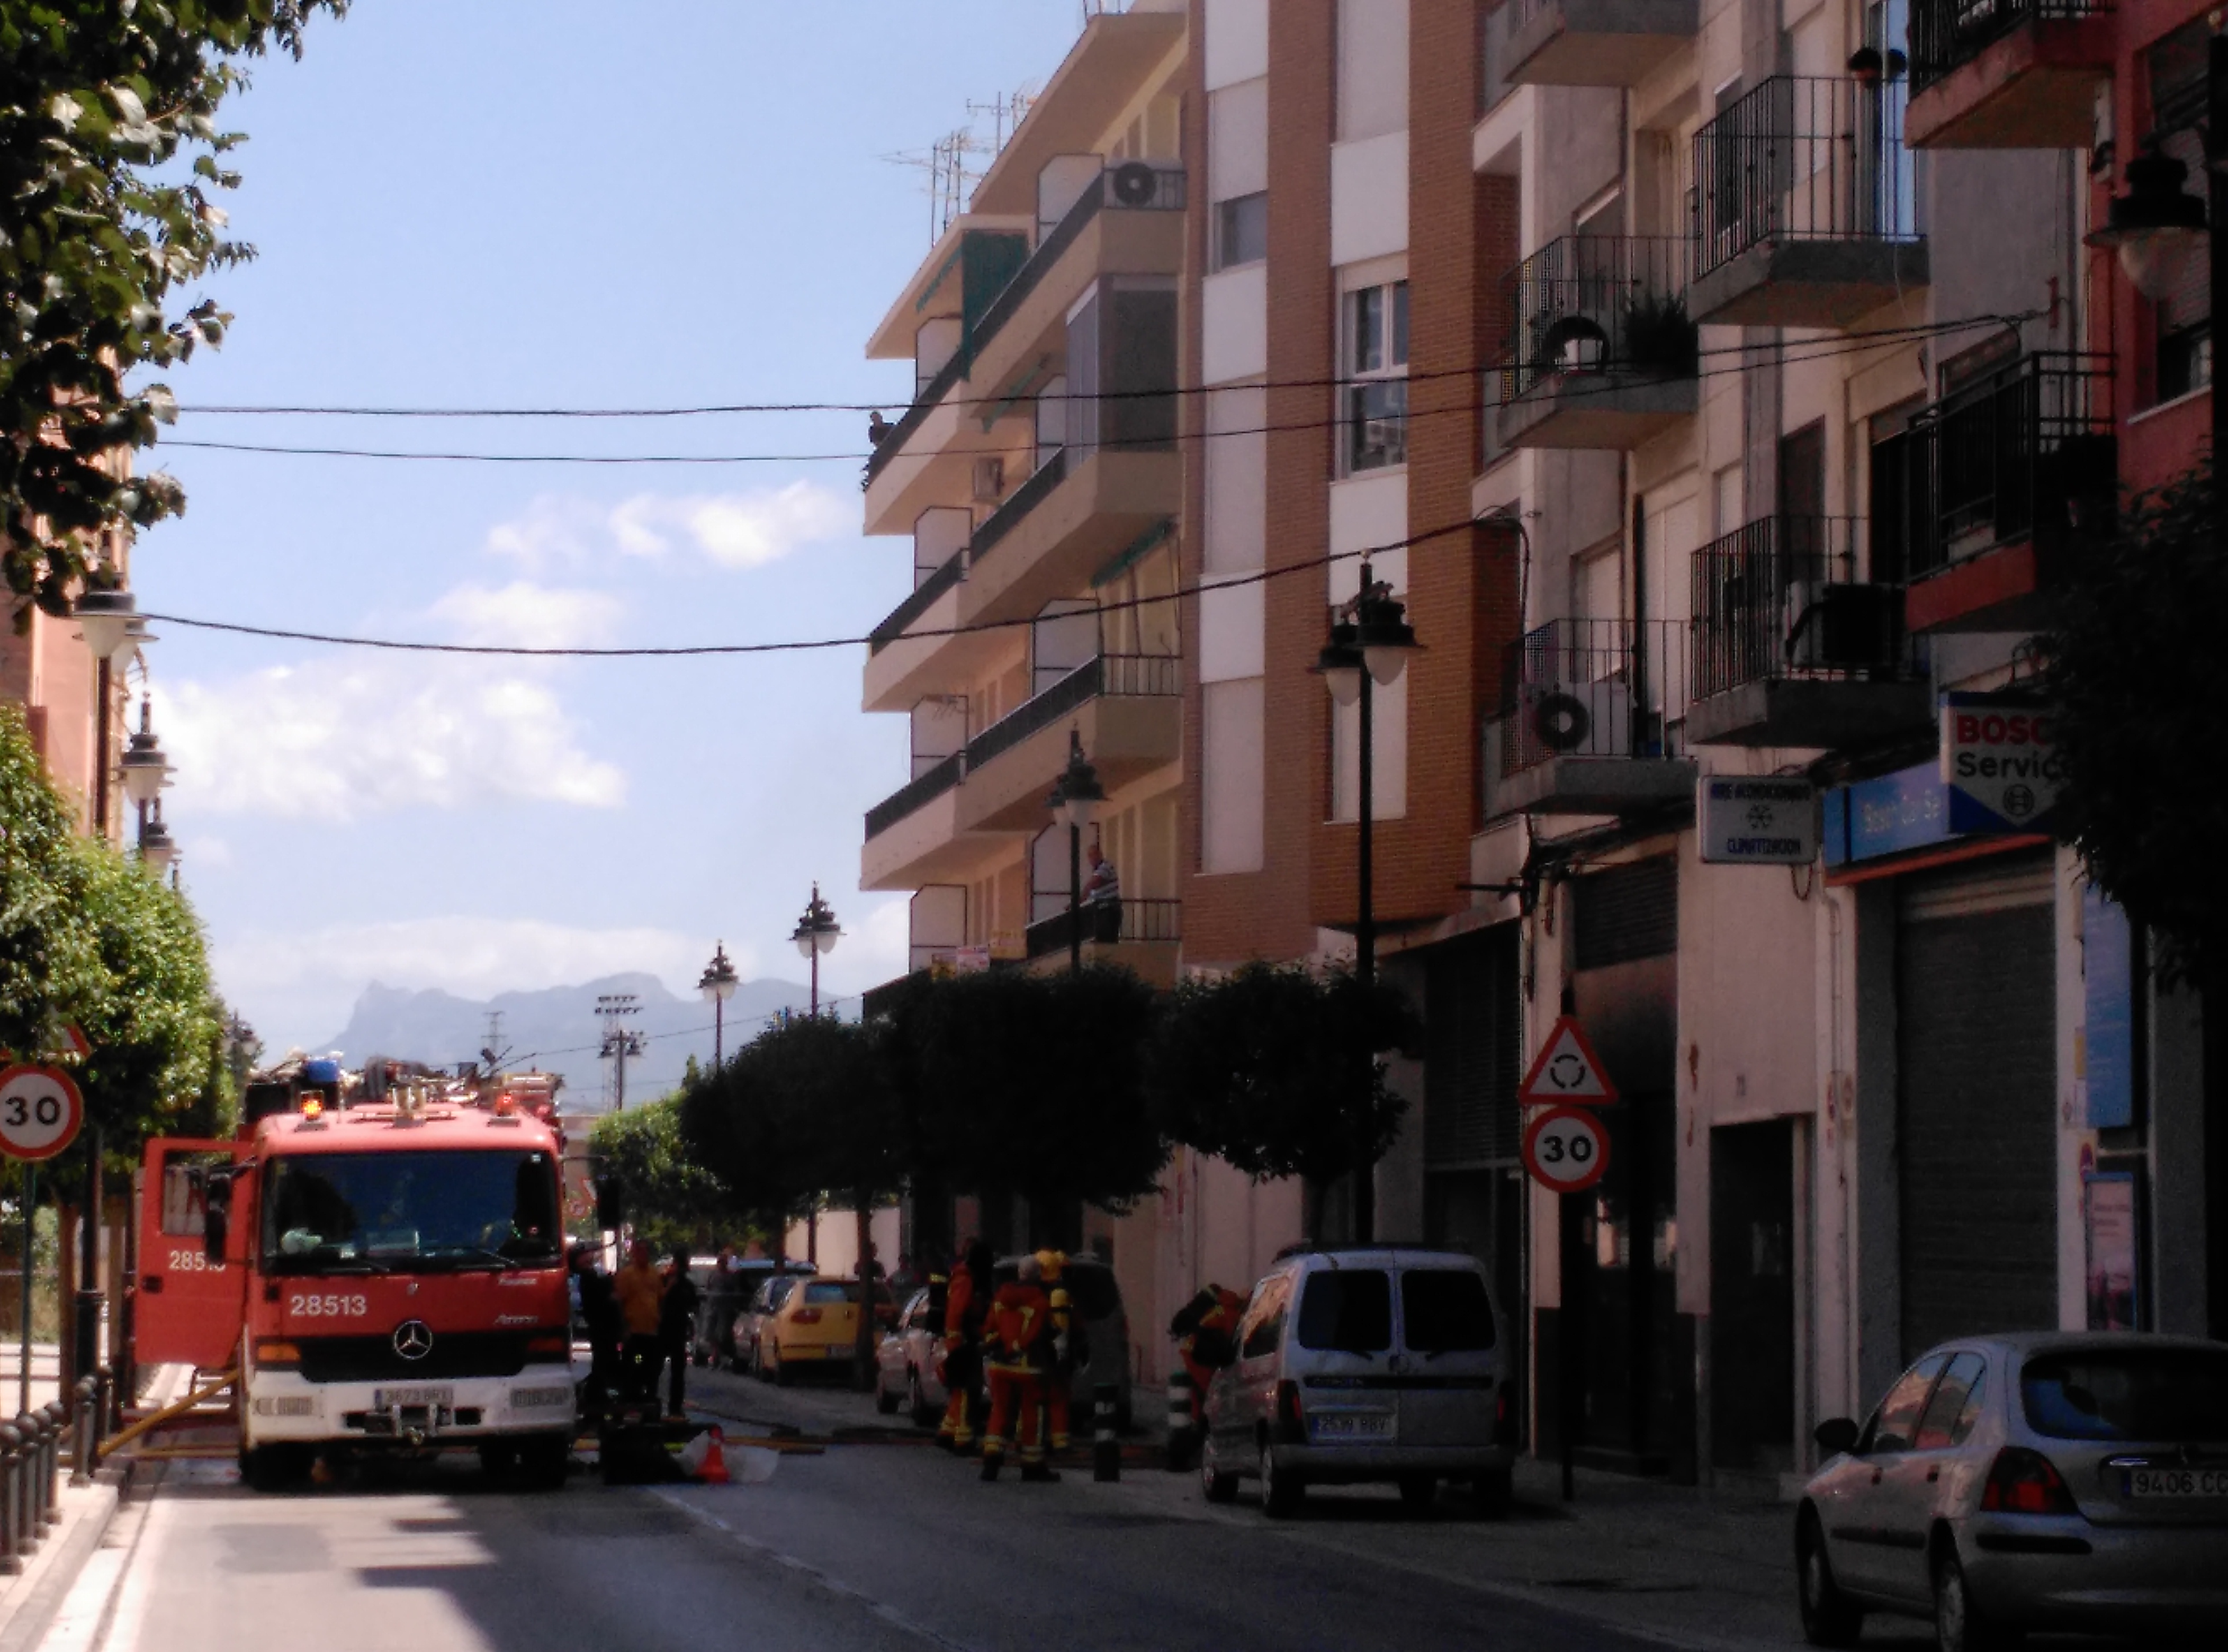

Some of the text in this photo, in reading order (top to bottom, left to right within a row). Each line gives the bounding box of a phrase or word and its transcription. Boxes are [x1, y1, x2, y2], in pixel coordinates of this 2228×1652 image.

[1957, 715, 2051, 746] BOSC
[1957, 751, 2060, 779] Servic
[5, 1096, 60, 1126] 30
[1543, 1135, 1592, 1162] 30
[169, 1250, 226, 1272] 285
[291, 1295, 367, 1316] 28513
[2136, 1472, 2192, 1493] 9406
